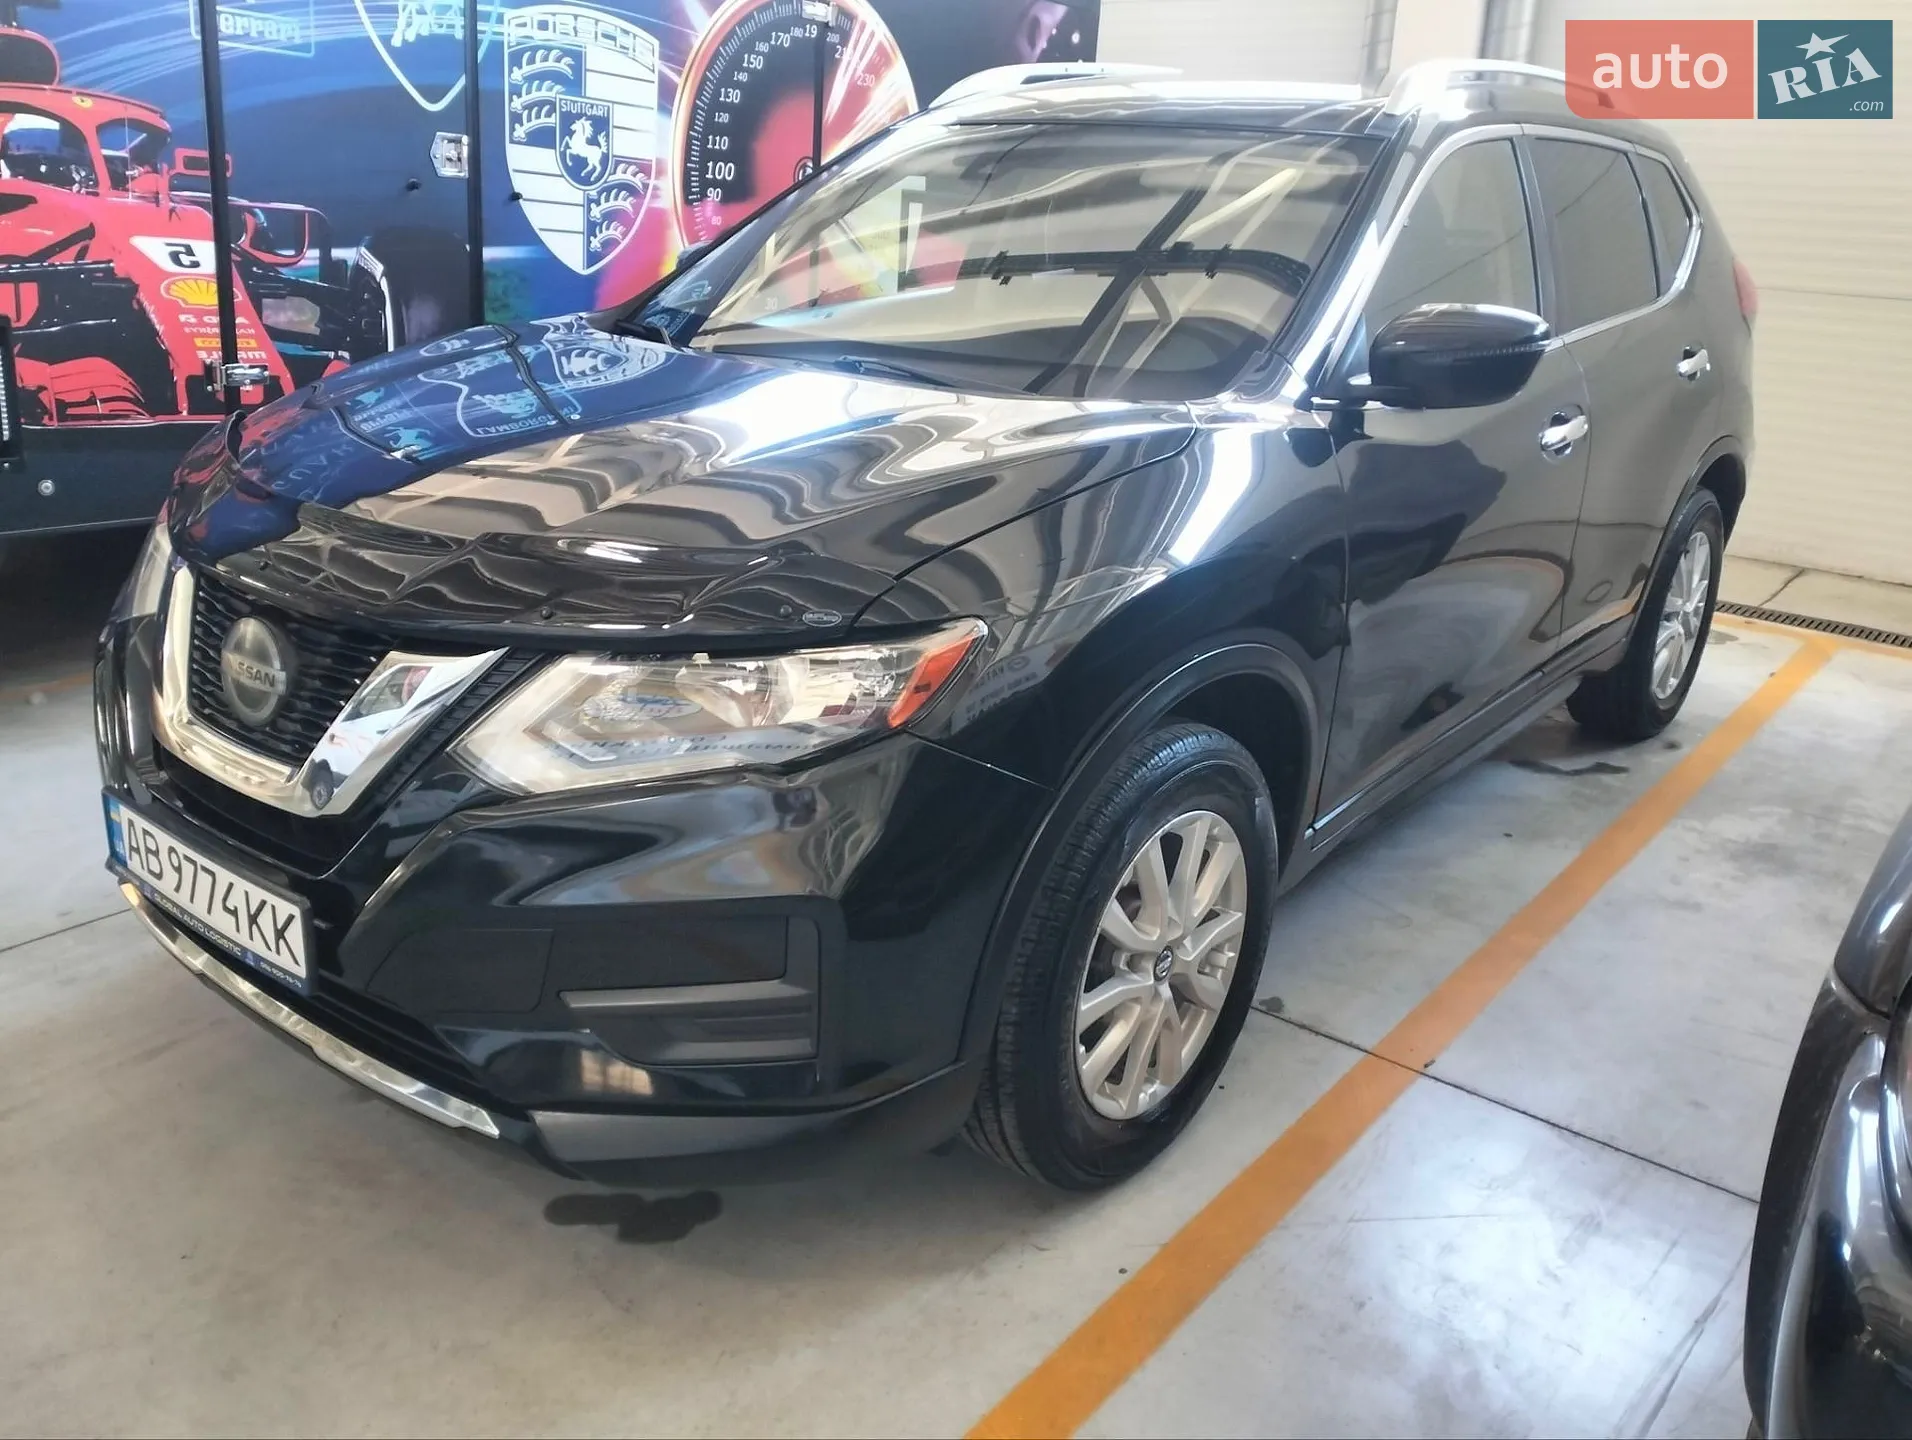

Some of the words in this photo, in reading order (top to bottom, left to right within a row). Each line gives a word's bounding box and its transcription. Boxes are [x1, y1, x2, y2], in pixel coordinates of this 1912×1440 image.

[219, 13, 303, 42] errari
[790, 26, 804, 38] 180
[804, 24, 818, 38] 19
[509, 13, 655, 72] PORSCHE
[770, 32, 791, 48] 170
[826, 32, 840, 43] 200
[755, 41, 770, 53] 160
[834, 45, 848, 58] 21
[742, 54, 764, 69] 150
[733, 71, 748, 82] 140
[856, 72, 876, 88] 230
[719, 88, 741, 103] 130
[560, 100, 609, 118] STUTTGART
[714, 112, 729, 124] 120
[706, 135, 729, 150] 110
[705, 161, 735, 181] 100
[706, 187, 722, 202] 90
[232, 658, 276, 688] SSAN
[183, 913, 204, 933] AUTO
